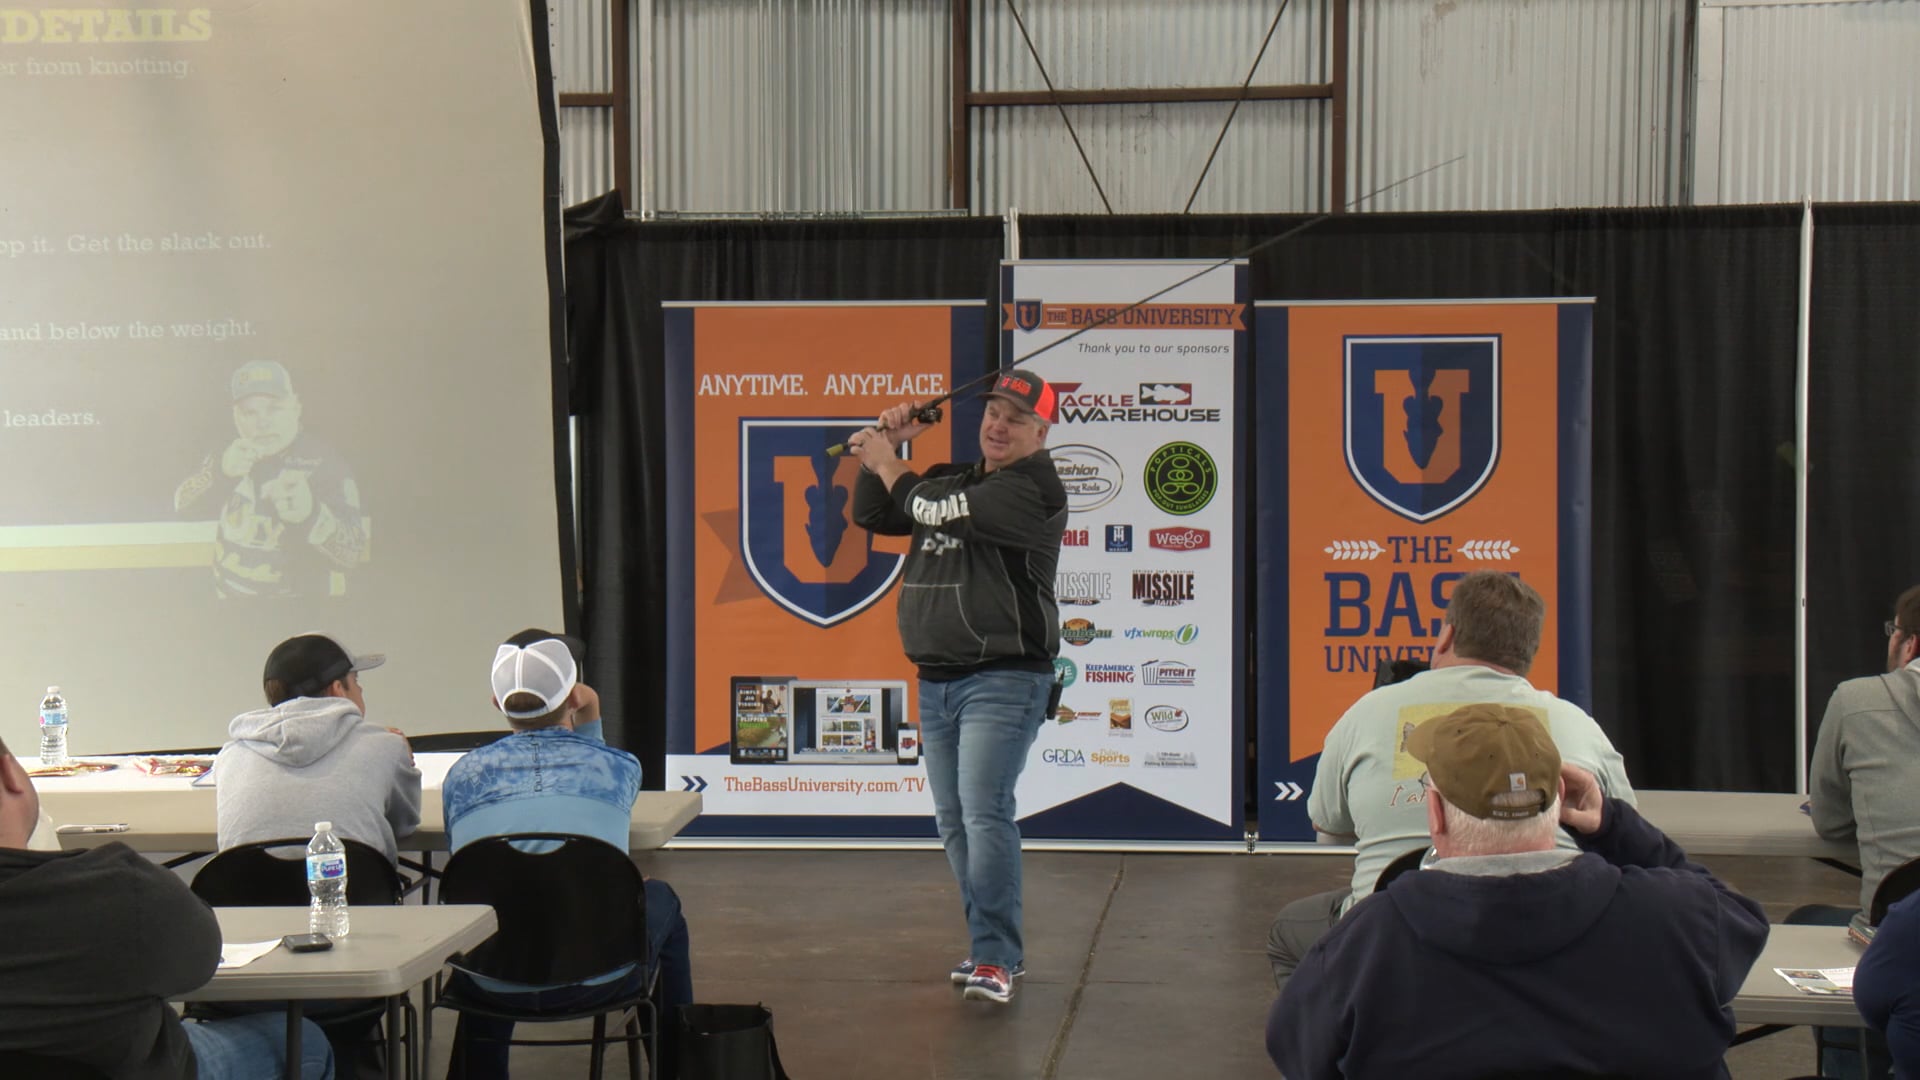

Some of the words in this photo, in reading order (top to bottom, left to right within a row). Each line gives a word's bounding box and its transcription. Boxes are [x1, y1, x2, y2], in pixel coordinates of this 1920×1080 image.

[1, 8, 212, 43] DETAILS
[27, 57, 82, 75] from
[32, 235, 55, 253] it.
[67, 234, 110, 252] Get
[118, 233, 153, 252] the
[160, 232, 222, 251] slack
[229, 232, 271, 249] out.
[1047, 311, 1067, 321] THE
[1072, 308, 1119, 325] BASS
[1123, 308, 1236, 325] UNIVERSITY
[0, 322, 41, 341] and
[49, 322, 120, 341] below
[129, 320, 164, 339] the
[171, 319, 257, 341] weight.
[1078, 343, 1111, 354] Thank
[1115, 345, 1136, 357] you
[1139, 344, 1151, 354] to
[1154, 346, 1174, 354] our
[1177, 345, 1230, 357] sponsors
[698, 374, 808, 396] ANYTIME.
[823, 374, 950, 396] ANYPLACE.
[3, 408, 100, 427] leaders.
[1060, 407, 1221, 424] WAREHOUSE
[1156, 530, 1204, 549] Weego
[1387, 536, 1453, 563] THE
[1132, 573, 1195, 600] MISSILE
[1124, 626, 1175, 640] vfxwraps
[1085, 672, 1135, 683] FISHING
[1159, 668, 1186, 677] PITCH
[1187, 668, 1197, 677] IT
[1151, 711, 1174, 721] Wild
[1042, 749, 1086, 764] GRDA
[1091, 752, 1131, 766] Sports
[724, 777, 926, 796] TheBassUniversity.com/TV
